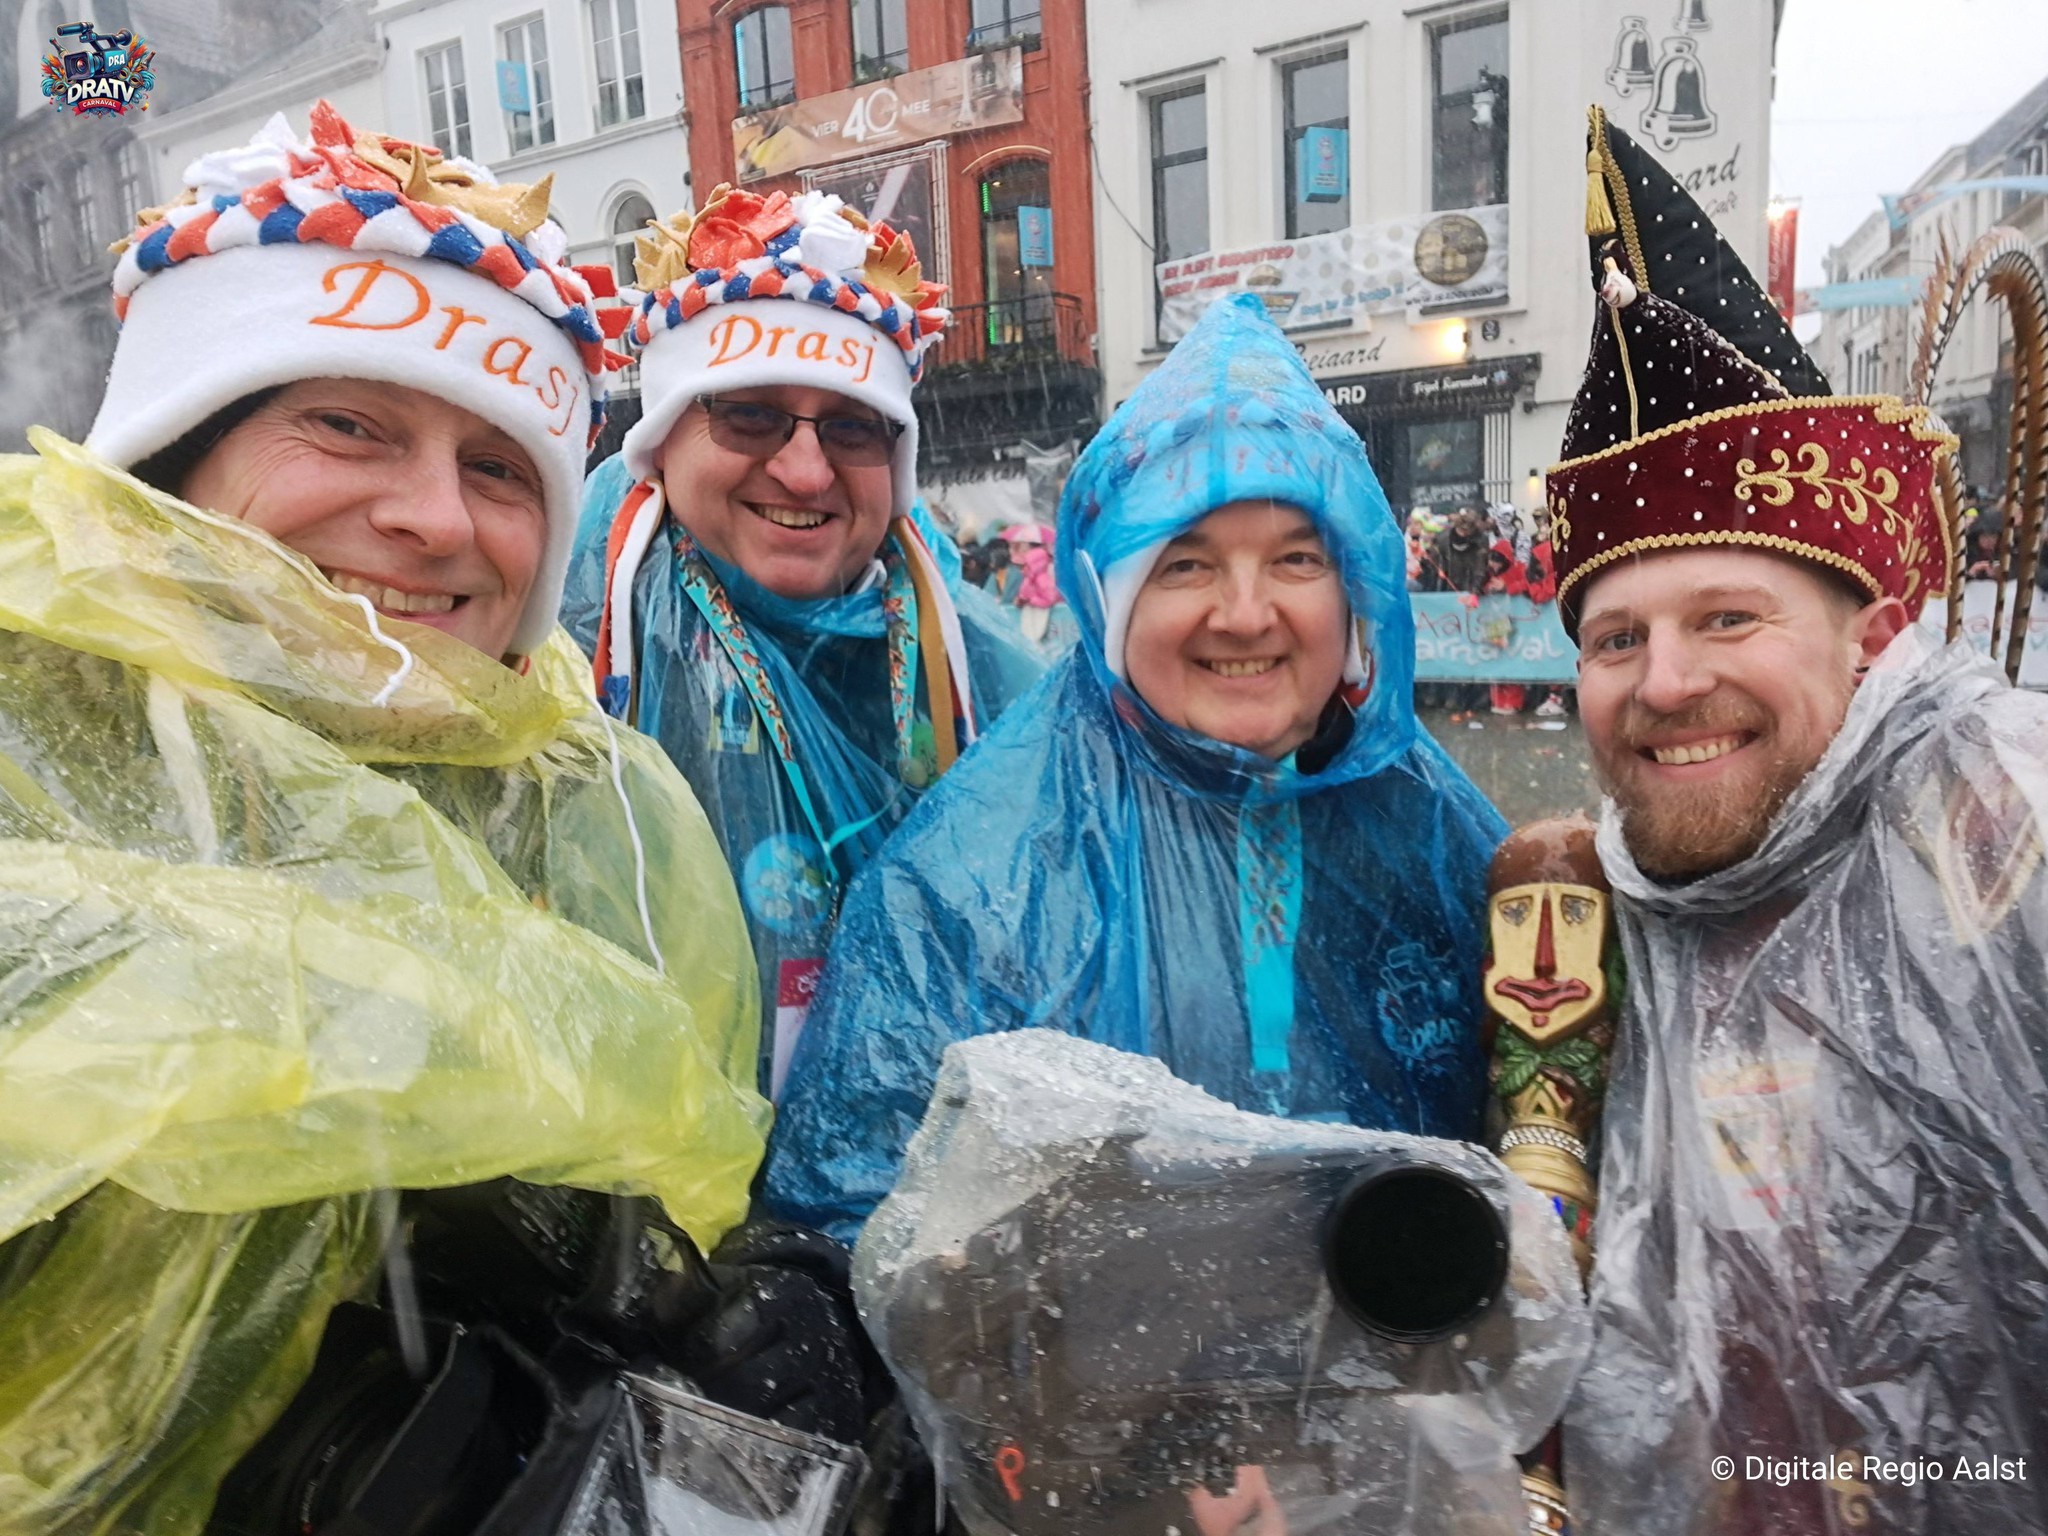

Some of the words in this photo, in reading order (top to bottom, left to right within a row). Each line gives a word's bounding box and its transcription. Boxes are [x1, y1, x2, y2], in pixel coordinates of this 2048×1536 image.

[811, 120, 839, 138] VIER
[902, 99, 931, 117] MEE
[1675, 143, 1740, 192] ard
[309, 258, 579, 437] Drasj
[707, 313, 878, 384] Drasj
[1416, 629, 1565, 667] arnaval
